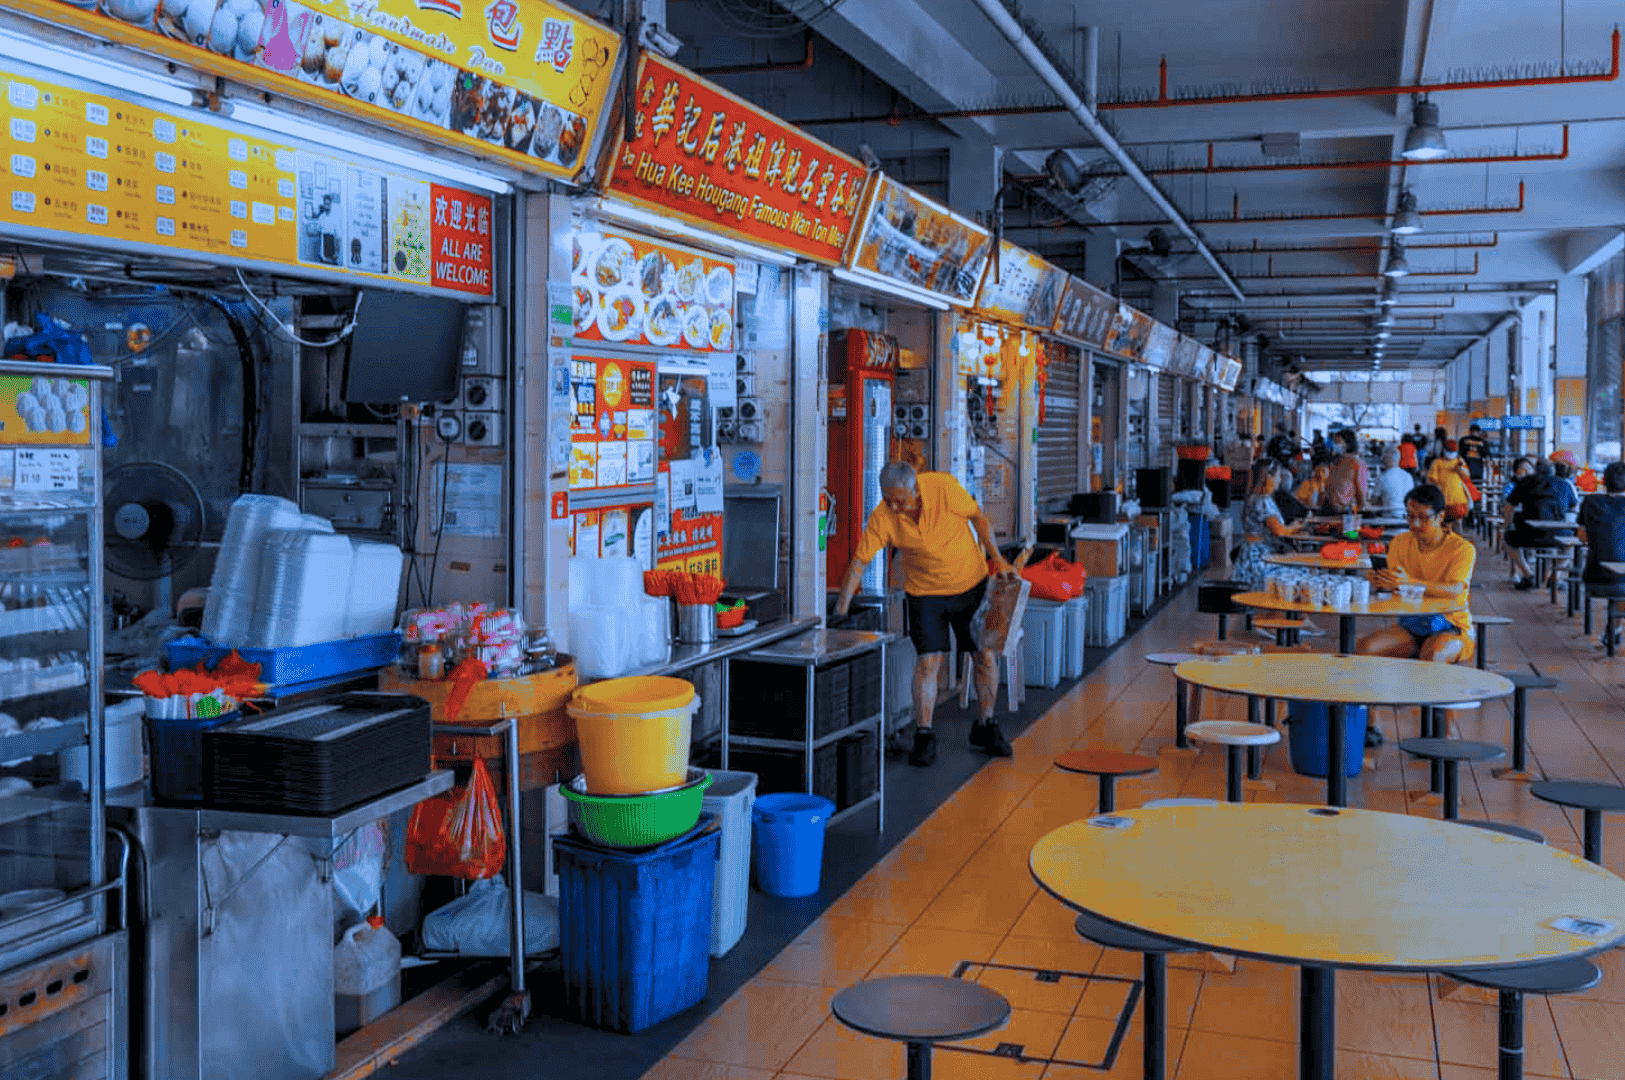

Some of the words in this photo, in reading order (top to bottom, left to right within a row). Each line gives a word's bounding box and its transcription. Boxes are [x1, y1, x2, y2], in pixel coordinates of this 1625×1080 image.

[635, 151, 666, 186] Hua
[667, 163, 695, 195] Kee
[694, 173, 750, 220] Hougang
[748, 194, 790, 230] Famous
[790, 210, 812, 237] Wan
[811, 218, 828, 243] Ton
[434, 194, 489, 236] 欢迎光临
[441, 237, 460, 258] ALL
[462, 241, 483, 262] ARE
[435, 261, 489, 287] WELCOME
